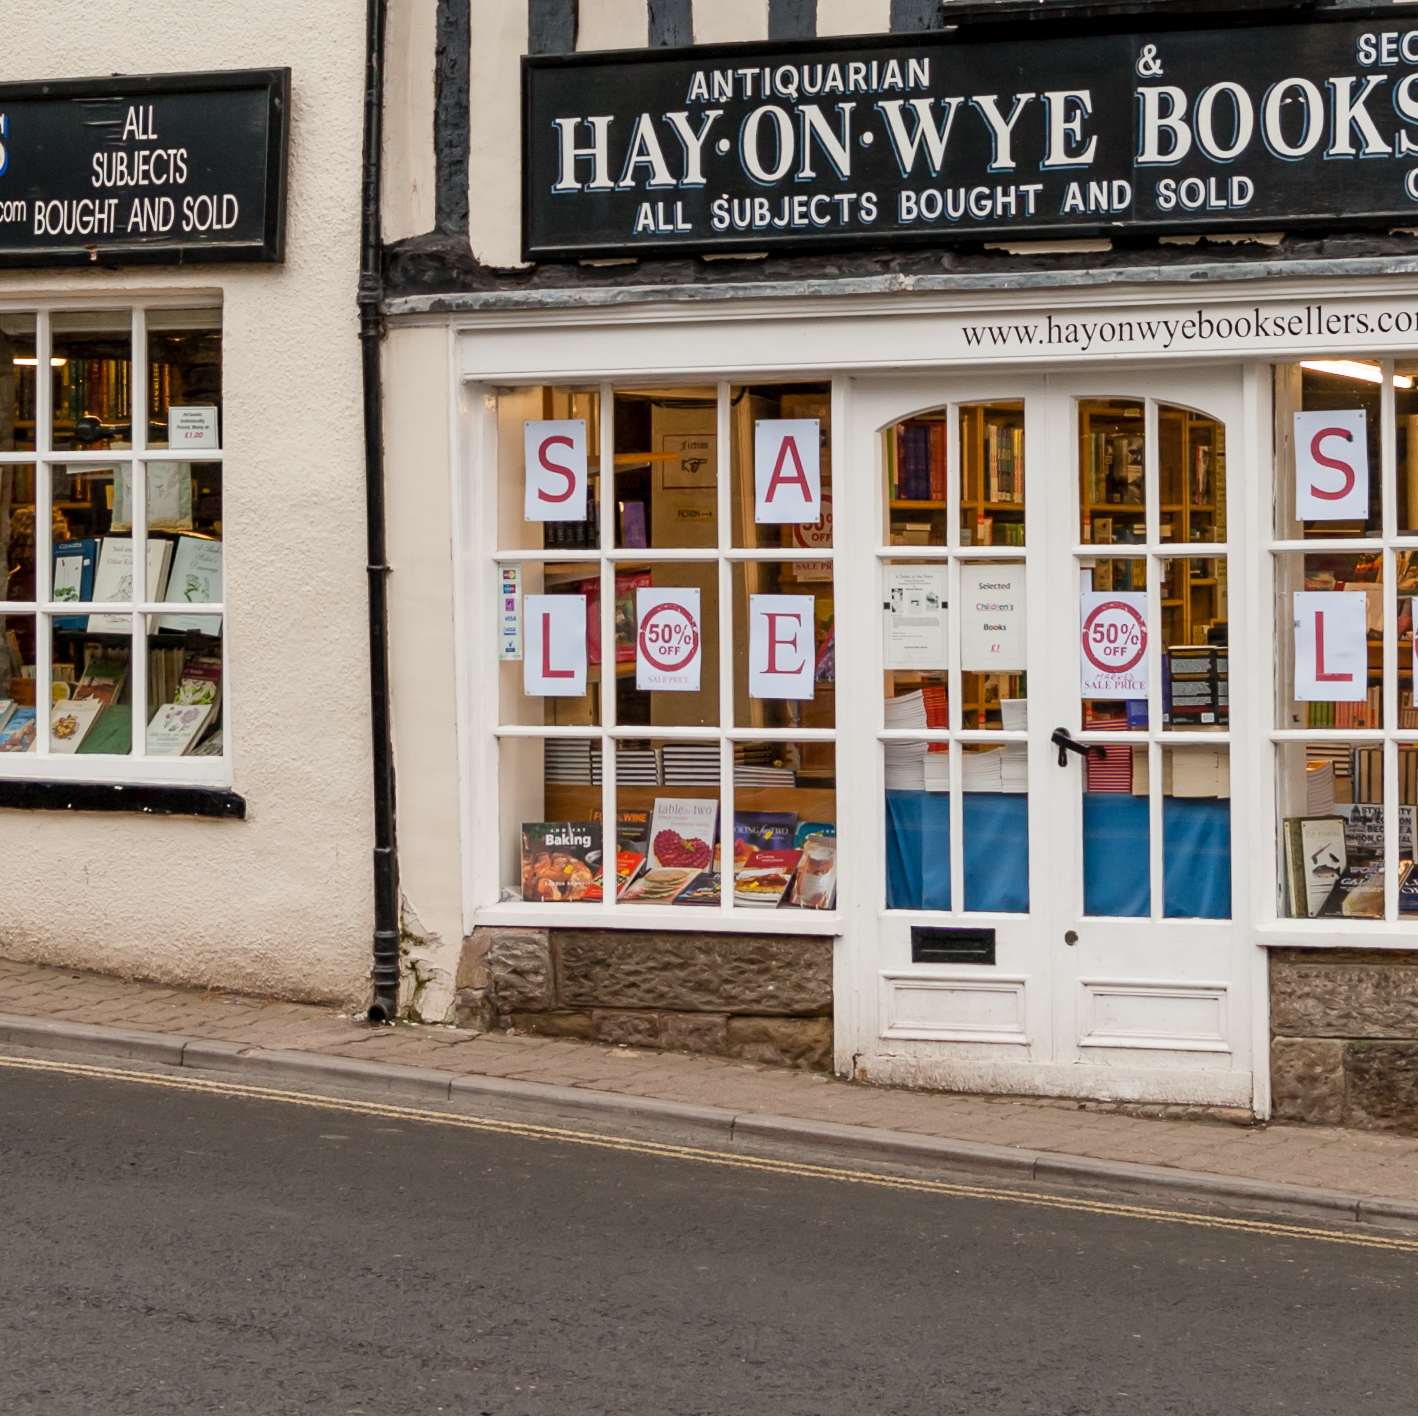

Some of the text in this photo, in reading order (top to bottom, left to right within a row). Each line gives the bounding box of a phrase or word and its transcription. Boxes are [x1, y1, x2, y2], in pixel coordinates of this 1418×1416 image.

[686, 57, 931, 104] ANTIQUARIAN
[1135, 44, 1163, 78] &
[123, 105, 158, 140] ALL
[91, 148, 188, 187] SUBJECTS
[33, 194, 239, 235] BOUGHT AND SOLD
[634, 200, 692, 234] ALL
[711, 191, 878, 230] SUBJECTS
[899, 183, 1044, 222] BOUGHT
[1060, 179, 1132, 216] AND
[1156, 176, 1254, 211] SOLD
[537, 435, 812, 503] S A
[1310, 427, 1356, 500] S
[976, 603, 1014, 611] Children's
[542, 613, 575, 678] L
[648, 624, 691, 645] 50%
[659, 646, 681, 655] OFF
[760, 612, 806, 675] E
[1092, 623, 1139, 645] 50%
[1104, 647, 1127, 656] OFF
[1315, 611, 1353, 682] L
[1084, 681, 1145, 690] SALE PRICE
[693, 805, 712, 815] two
[545, 833, 591, 847] Baking
